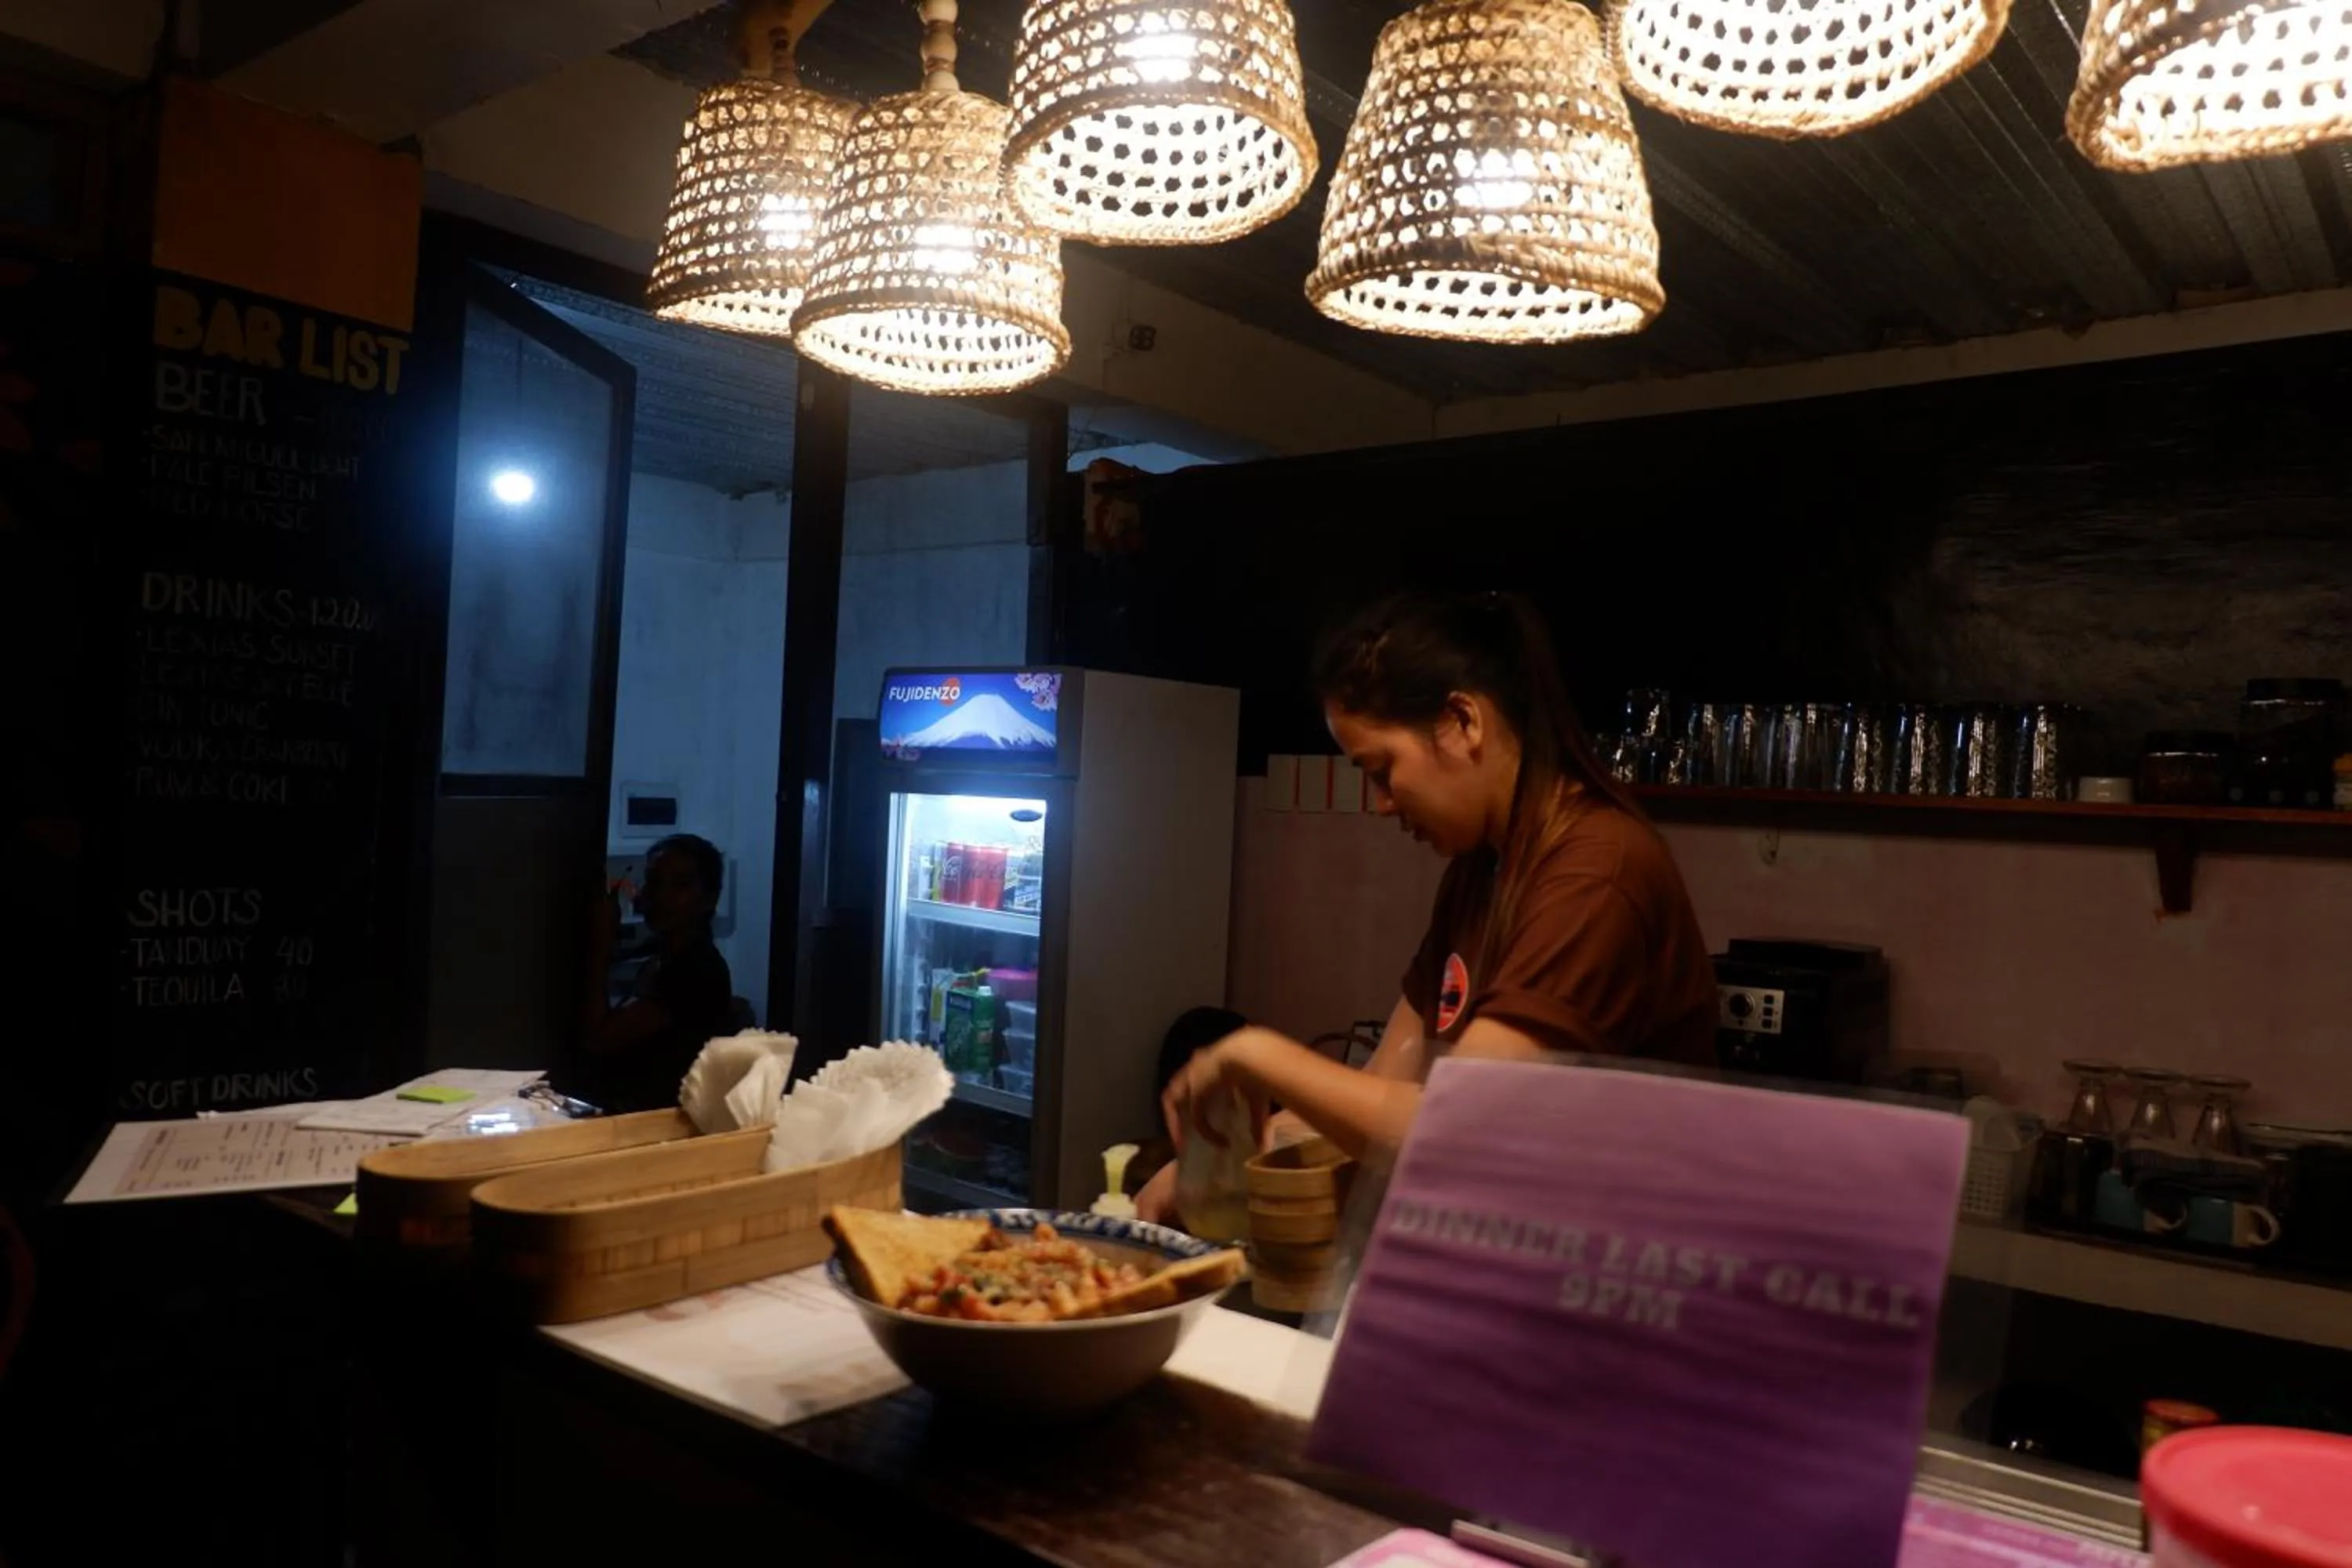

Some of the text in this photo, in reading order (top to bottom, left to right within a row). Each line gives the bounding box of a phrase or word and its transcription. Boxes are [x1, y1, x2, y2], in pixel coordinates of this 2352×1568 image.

[153, 285, 410, 396] BAR LIST
[157, 360, 267, 426] BEER
[223, 464, 317, 502] PILSEN
[140, 570, 294, 628] DRINKS
[888, 685, 961, 703] FUJIDENZO
[126, 886, 263, 928] SHOTS
[274, 935, 314, 968] 40
[131, 971, 246, 1007] TEQUILA
[128, 1066, 319, 1110] SOFT DRINKS
[1392, 1200, 1921, 1330] DINNER LAST CALL
[1558, 1273, 1685, 1331] 9PM
